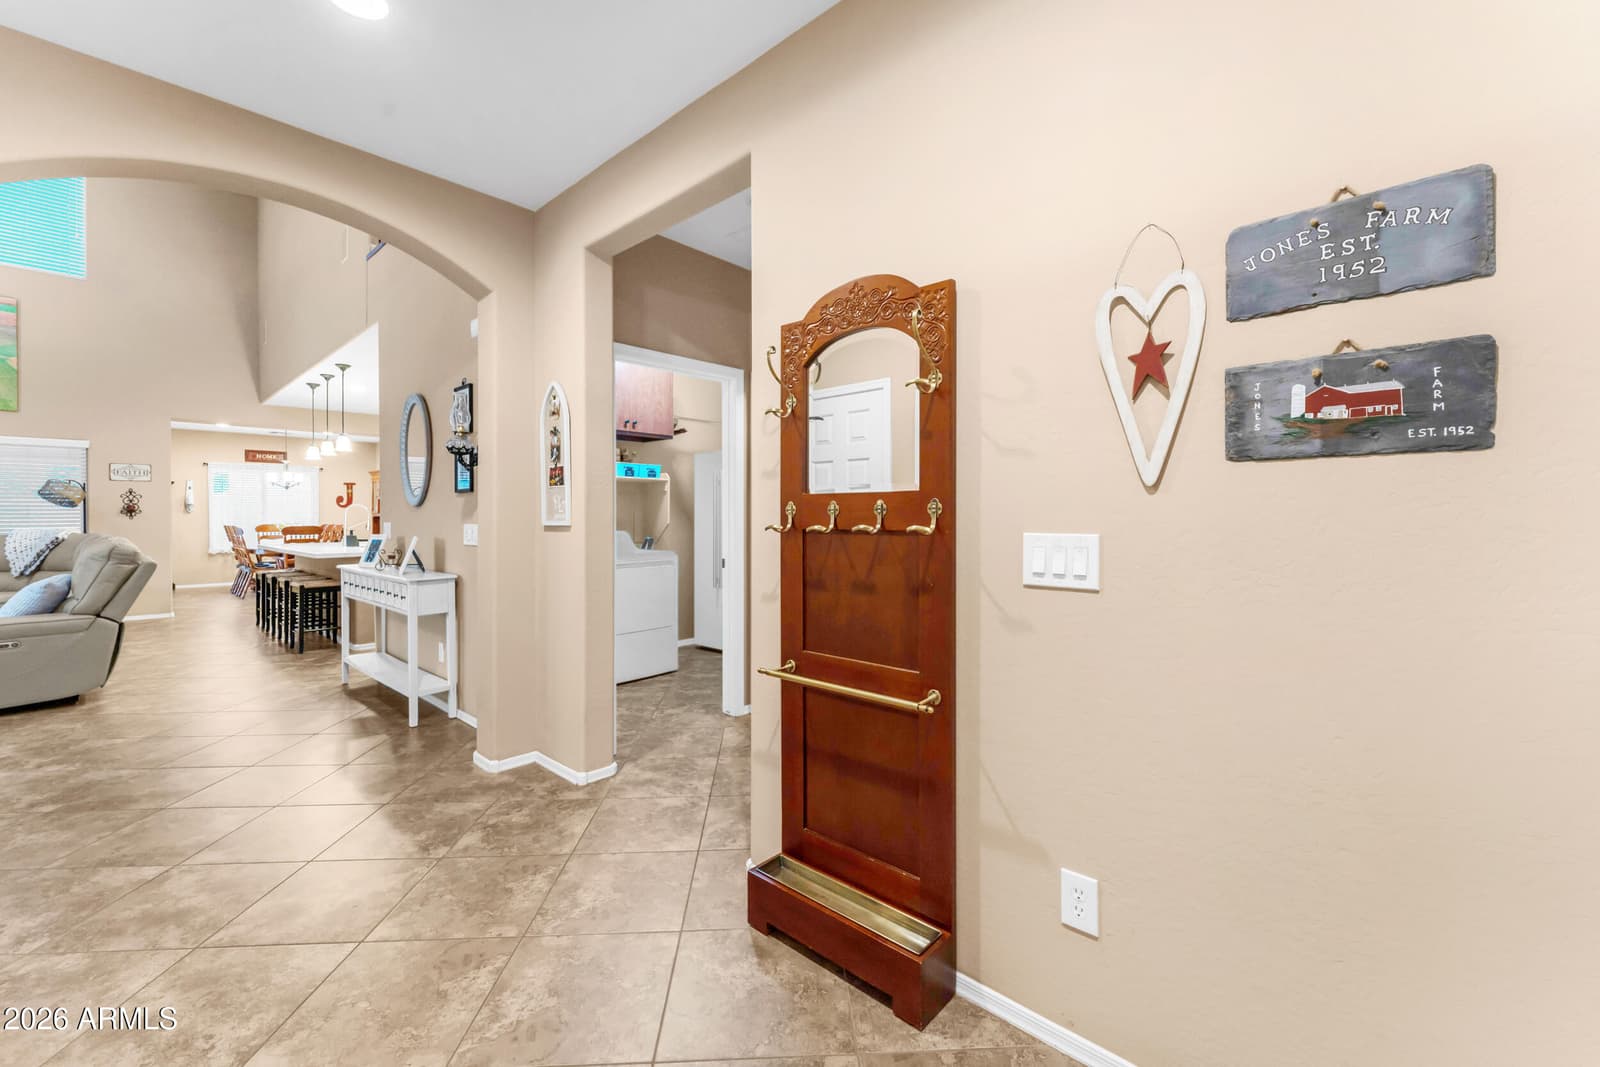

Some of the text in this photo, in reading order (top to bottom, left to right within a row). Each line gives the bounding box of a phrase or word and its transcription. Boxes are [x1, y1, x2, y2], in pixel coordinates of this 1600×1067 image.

[1243, 206, 1454, 272] JONES FARM
[1319, 233, 1380, 260] EST.
[1319, 256, 1386, 283] 1952
[1432, 366, 1445, 412] FARM
[1253, 382, 1262, 432] JONES
[1407, 425, 1475, 438] EST. 1952
[336, 482, 356, 509] J
